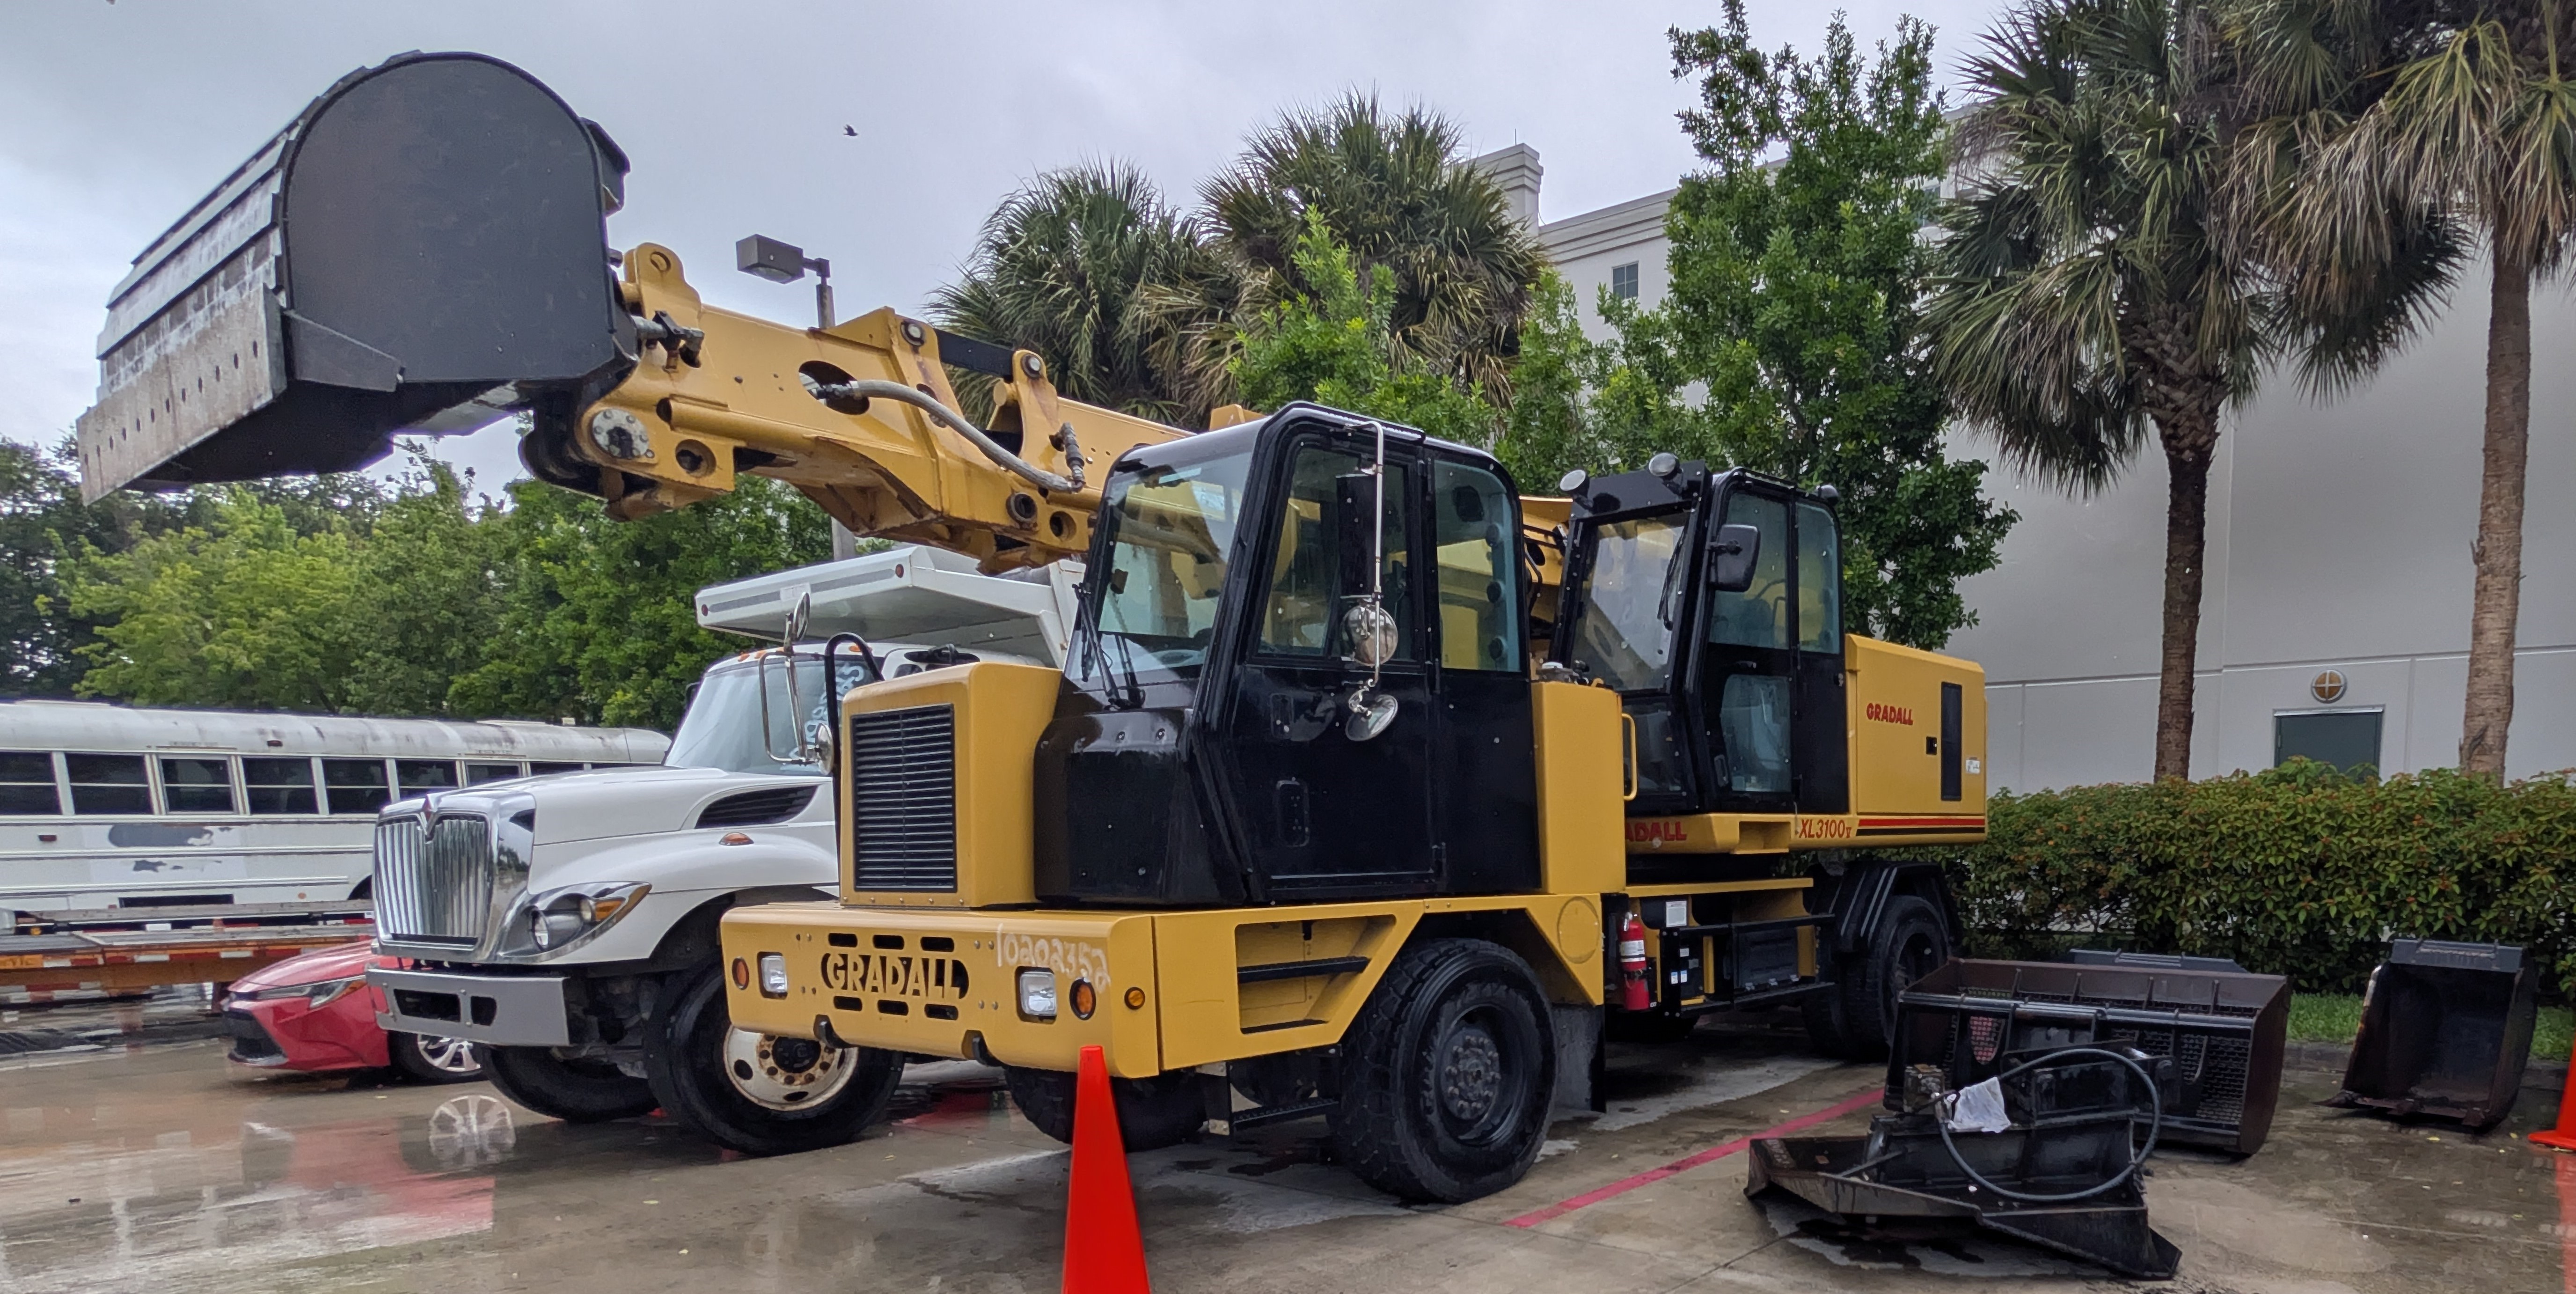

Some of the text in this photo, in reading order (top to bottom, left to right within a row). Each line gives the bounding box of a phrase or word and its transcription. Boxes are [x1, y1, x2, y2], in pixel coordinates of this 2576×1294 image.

[1866, 703, 1913, 726] GRADALL
[1625, 822, 1687, 841] ADALL
[826, 953, 960, 999] GRADALL
